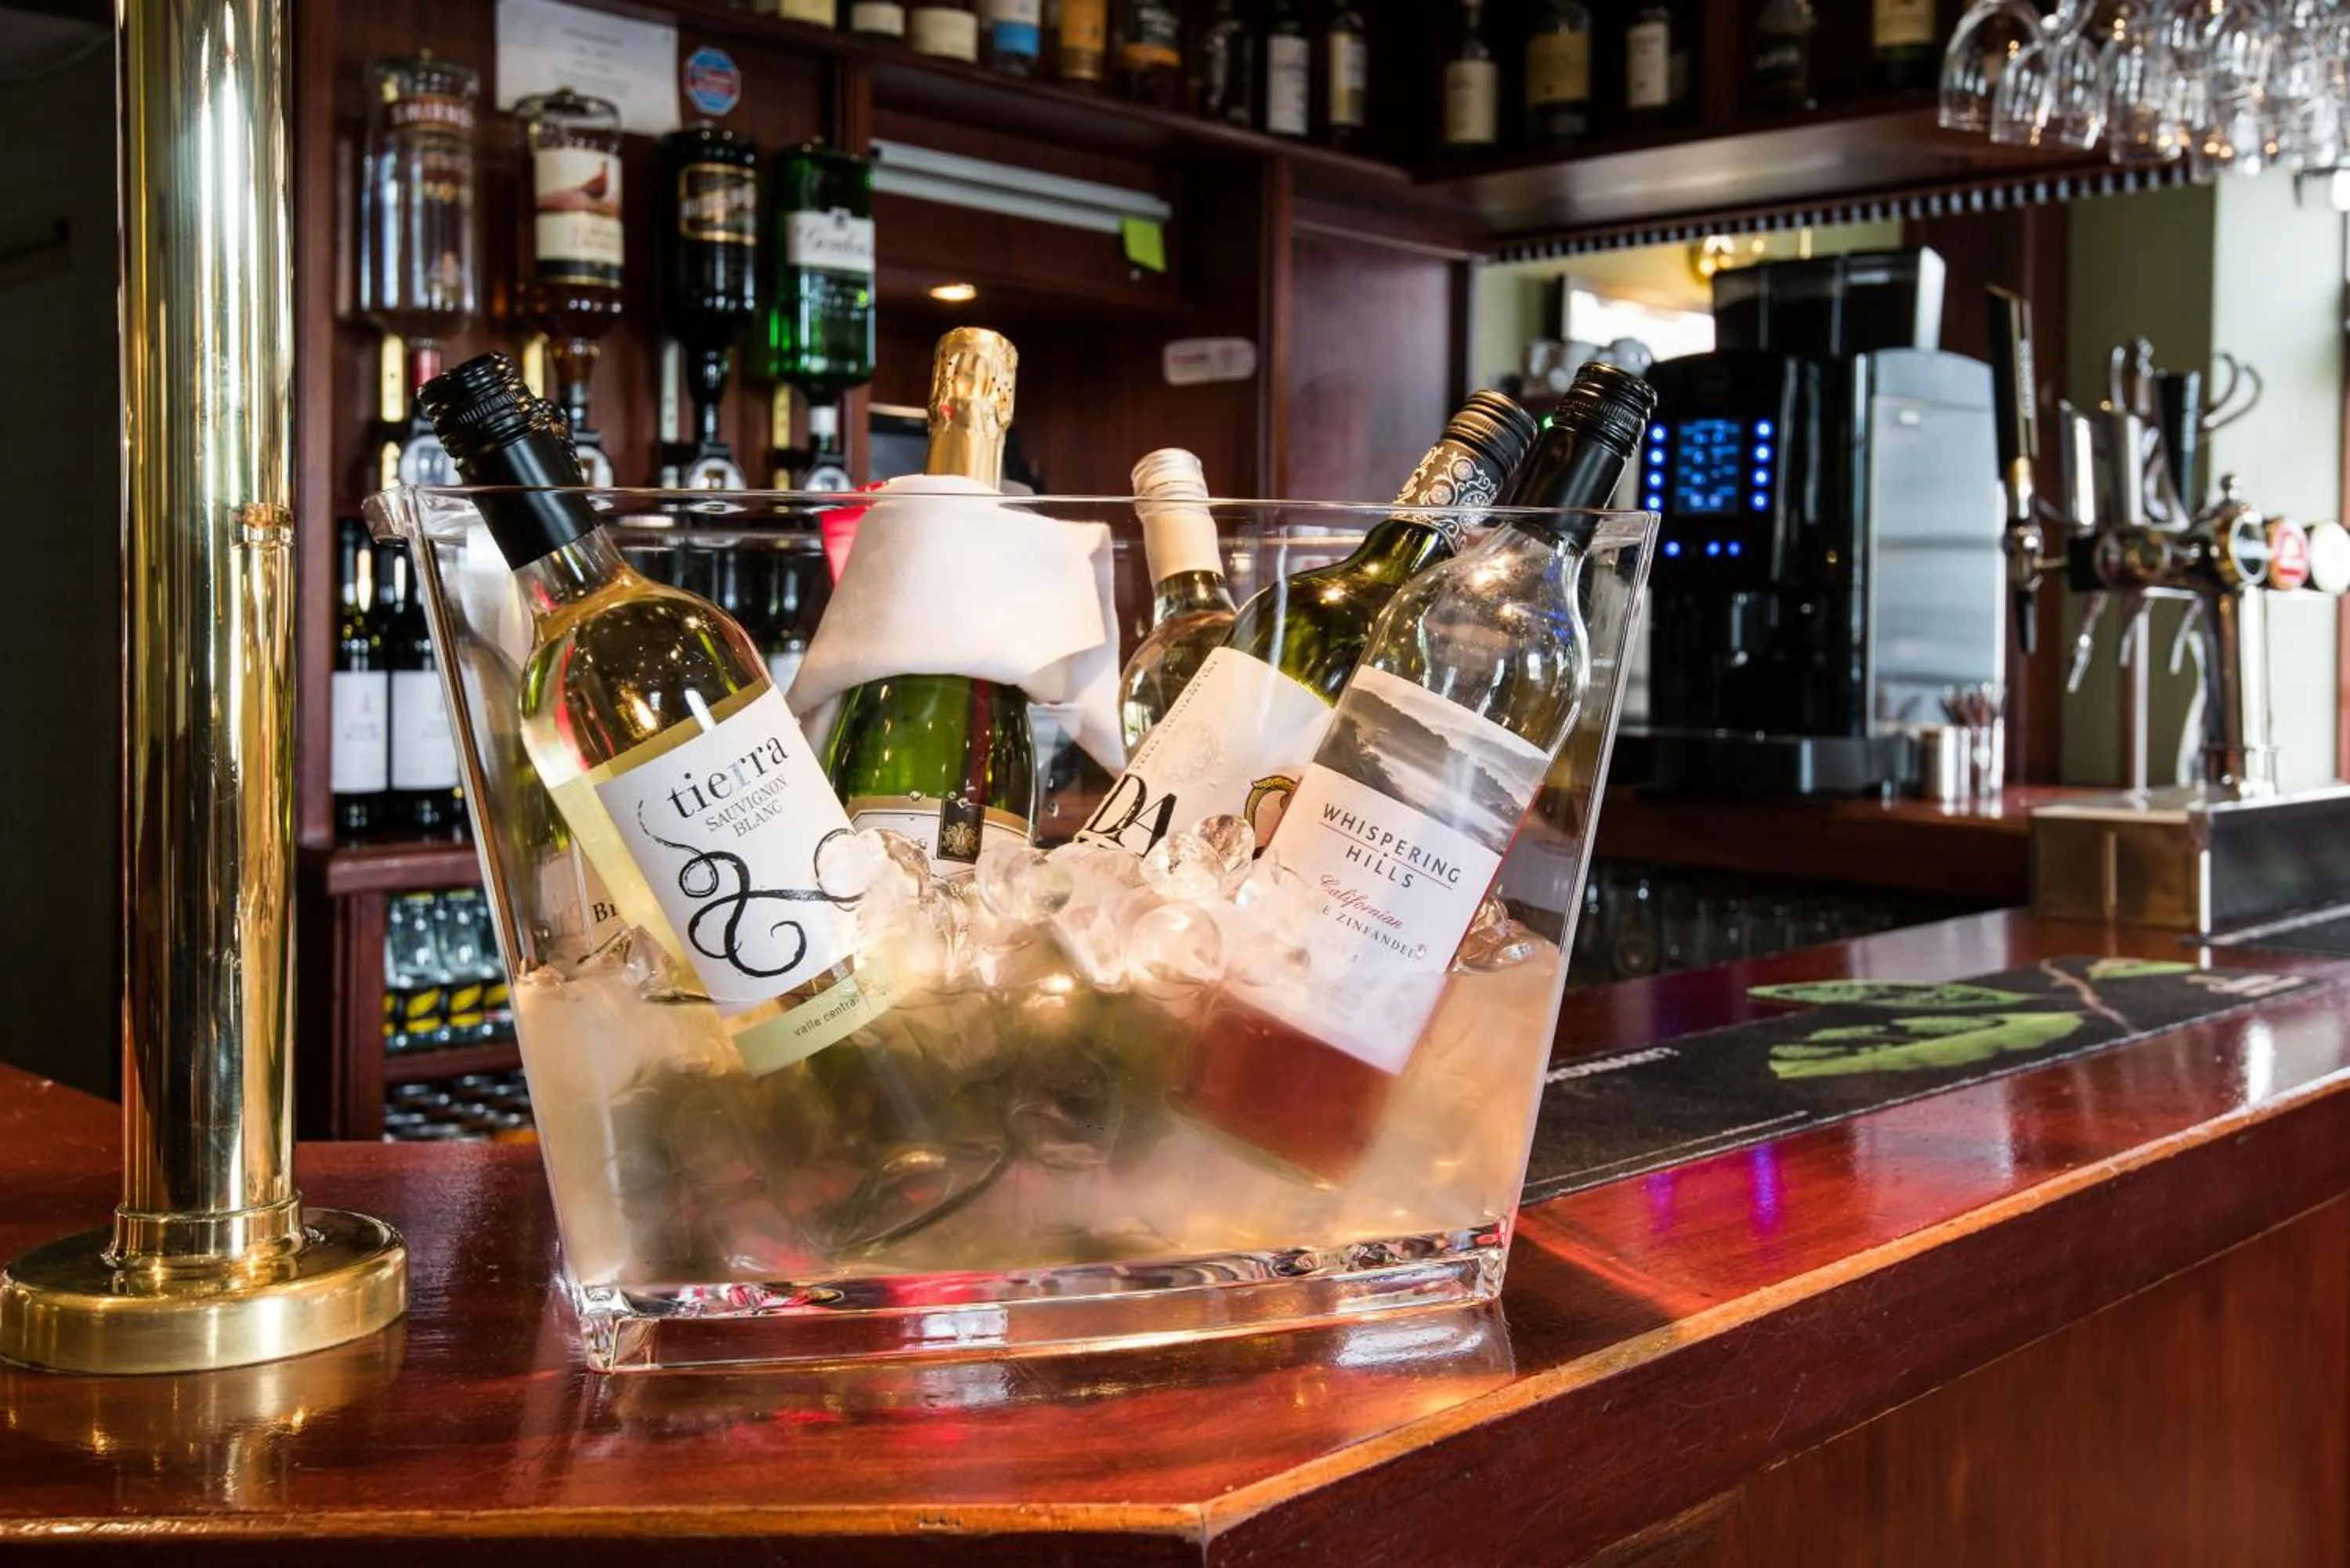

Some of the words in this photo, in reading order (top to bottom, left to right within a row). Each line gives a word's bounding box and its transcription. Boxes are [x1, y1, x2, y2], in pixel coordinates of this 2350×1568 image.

[667, 736, 789, 818] tierra
[705, 774, 790, 832] SAUVIGNON
[732, 799, 783, 837] BLANC
[1322, 803, 1461, 883] WHISPERING
[1345, 844, 1415, 888] HILLS
[1319, 873, 1403, 930] Californian
[794, 1018, 822, 1038] valle
